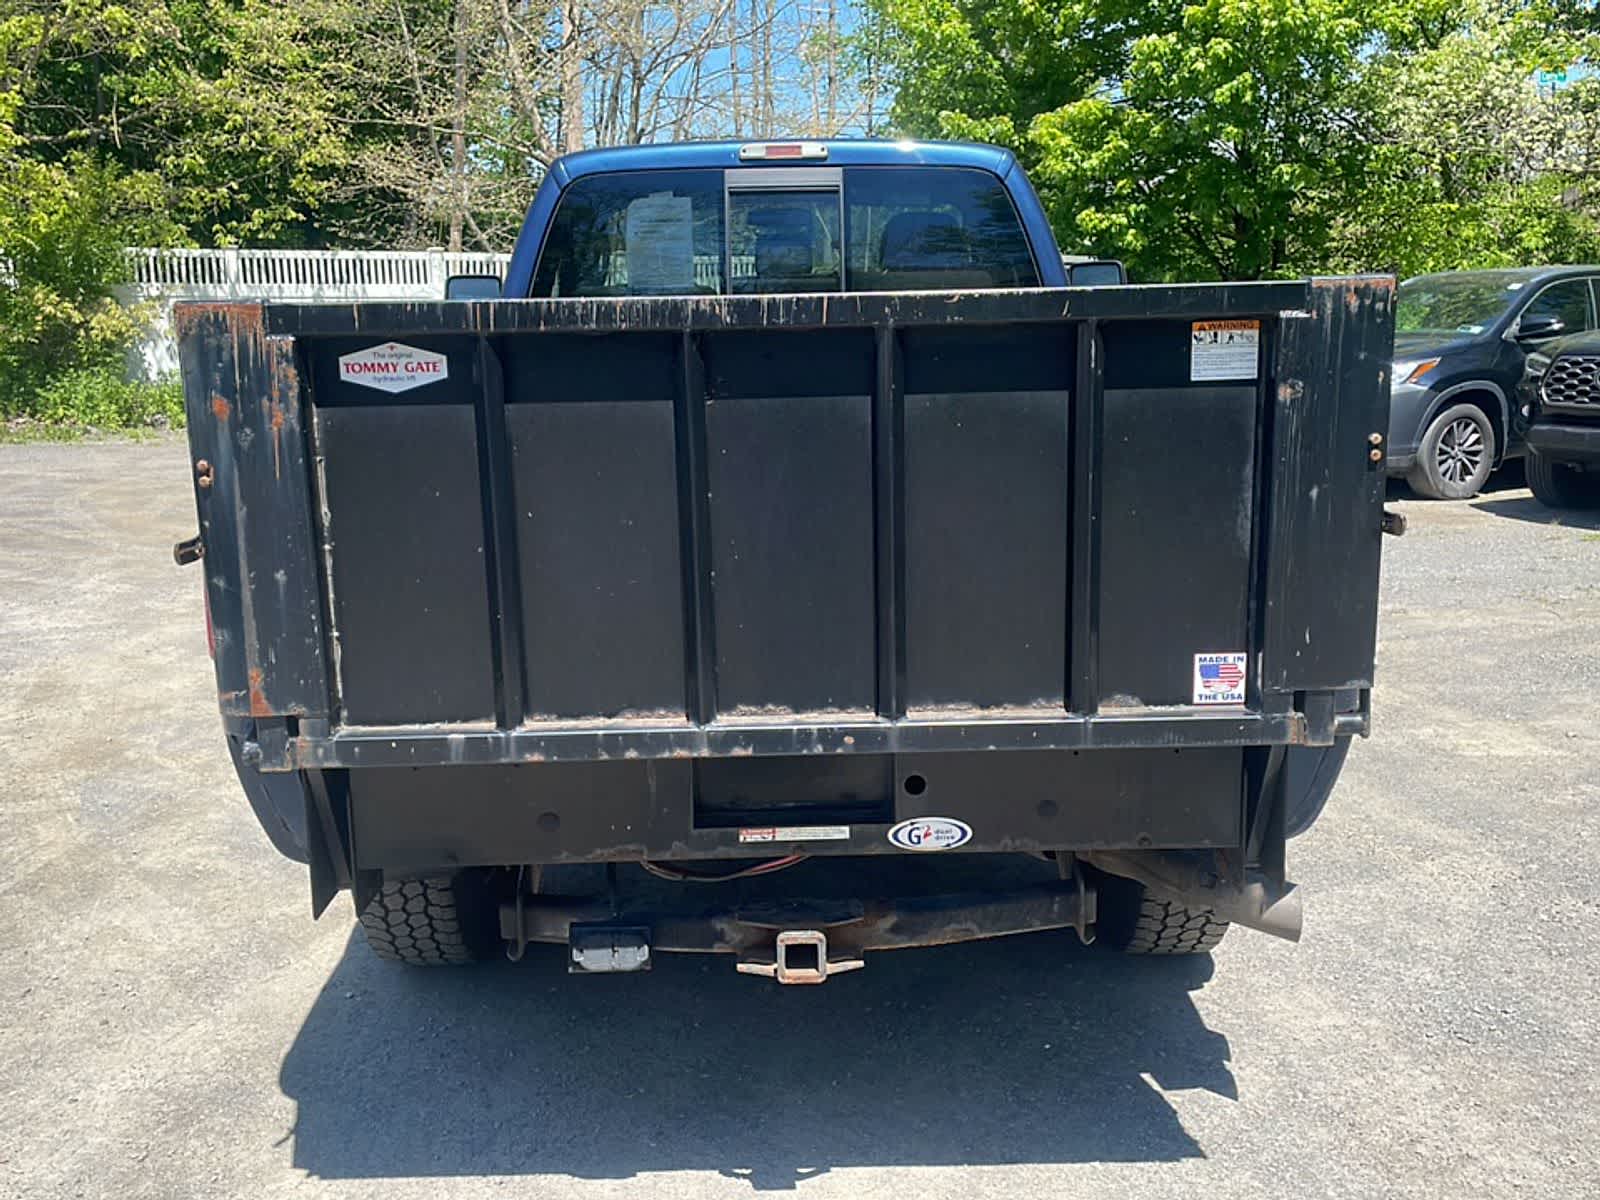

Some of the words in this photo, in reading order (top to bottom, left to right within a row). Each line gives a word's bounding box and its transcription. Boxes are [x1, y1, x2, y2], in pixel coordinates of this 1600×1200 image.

[1209, 321, 1254, 329] WARNING
[344, 362, 399, 374] TOMMY
[404, 361, 440, 373] GATE
[1222, 693, 1243, 701] USA
